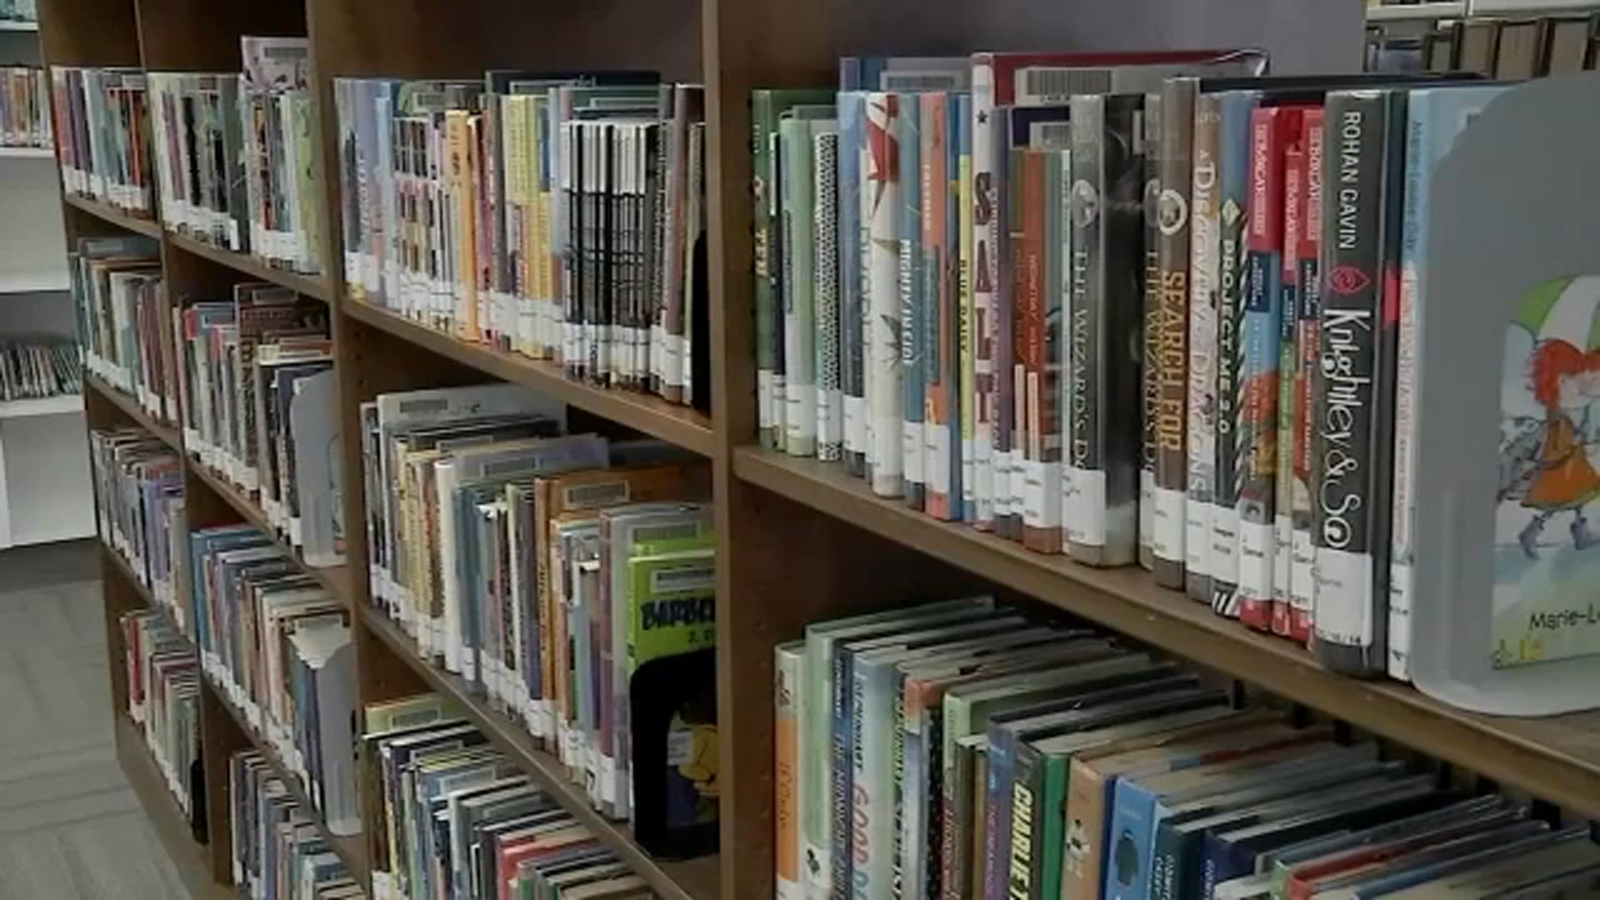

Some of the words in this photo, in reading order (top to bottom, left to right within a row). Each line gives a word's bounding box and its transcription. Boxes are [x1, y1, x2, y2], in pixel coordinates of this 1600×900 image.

[1342, 111, 1362, 180] ROHAN
[1338, 188, 1358, 249] GAVIN
[1073, 246, 1089, 299] THE
[1220, 239, 1235, 354] PROJECT
[1161, 271, 1186, 387] SEARCH
[1219, 357, 1233, 393] ME
[1320, 308, 1371, 450] Knightley
[1159, 398, 1182, 452] FOR
[1217, 400, 1231, 434] 2.0
[1327, 447, 1358, 478] &
[1322, 478, 1361, 549] So
[1009, 781, 1034, 888] CHARLIE
